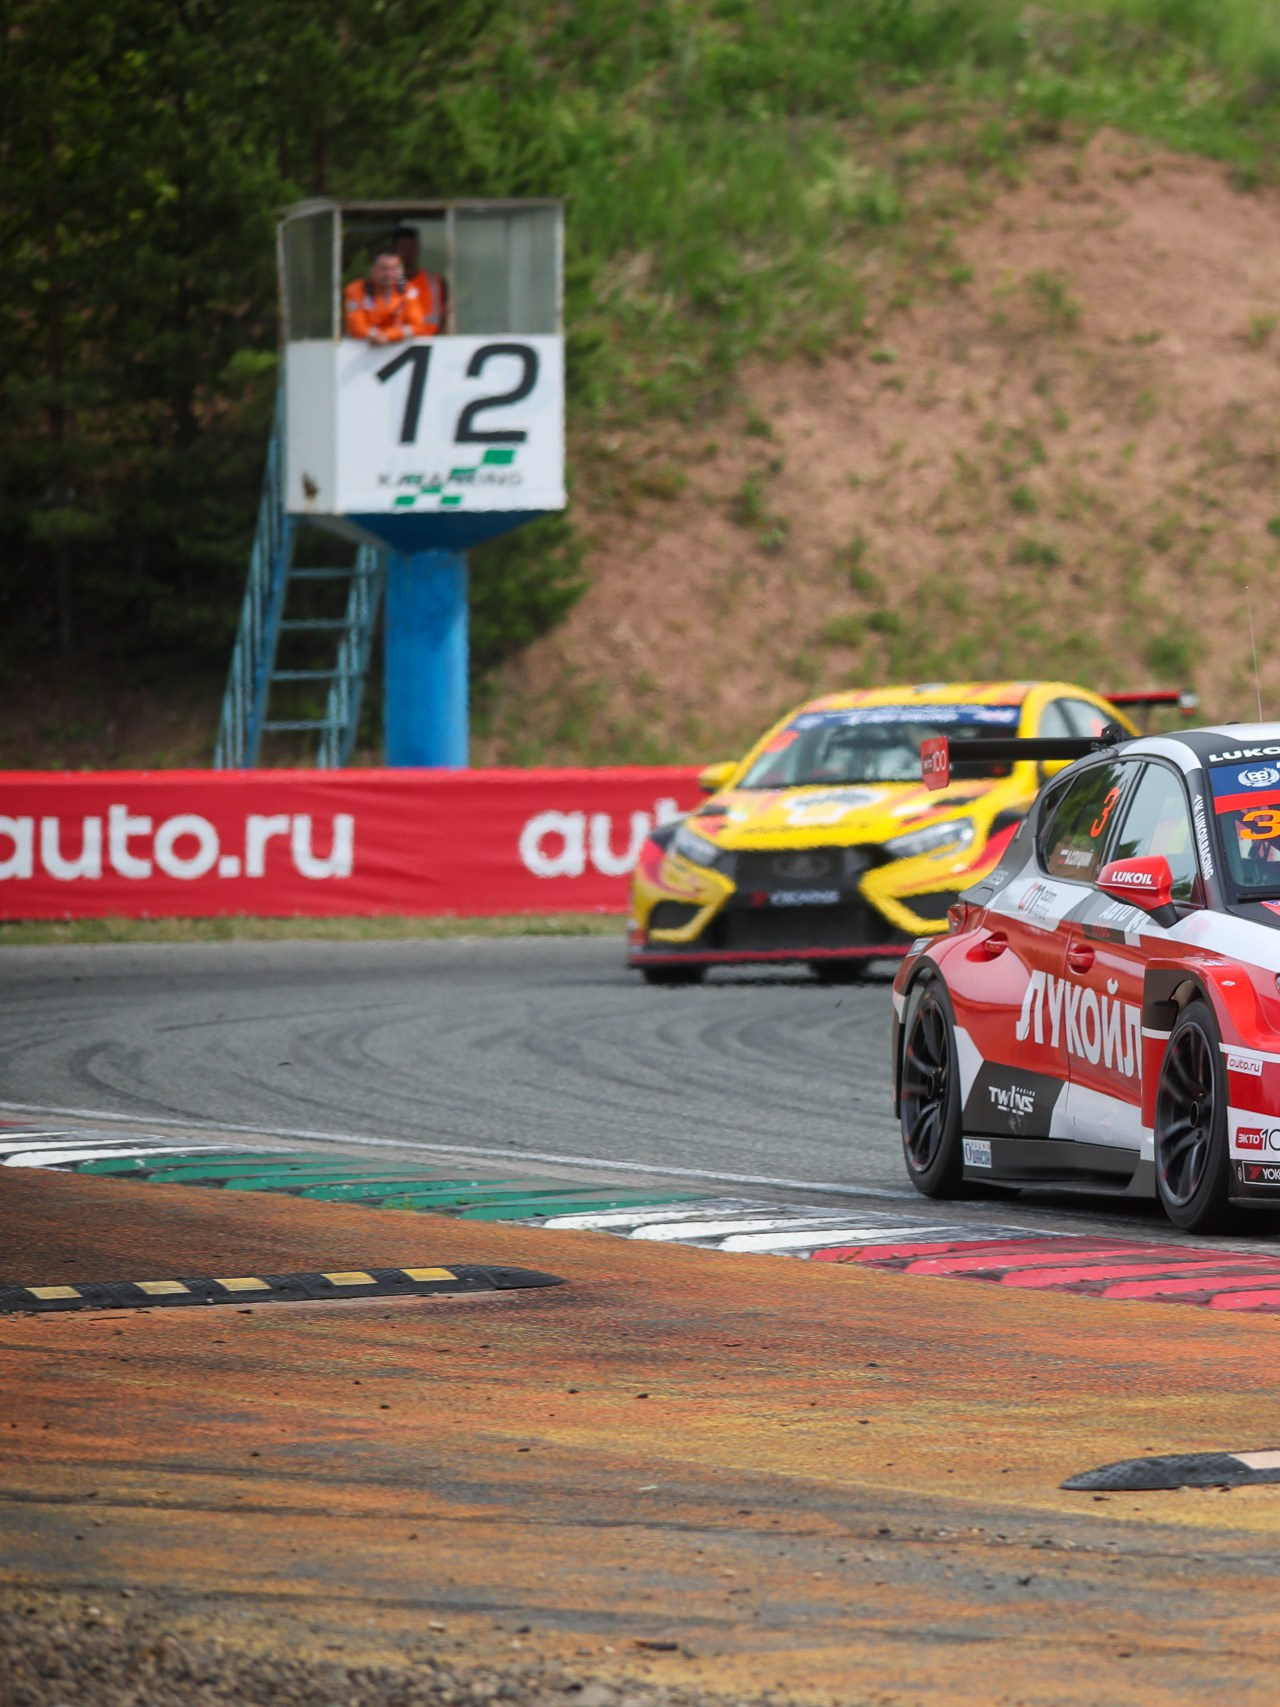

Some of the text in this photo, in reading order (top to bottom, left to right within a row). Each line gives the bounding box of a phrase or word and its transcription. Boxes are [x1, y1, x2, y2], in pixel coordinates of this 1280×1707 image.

[375, 342, 539, 444] 12
[1090, 787, 1120, 838] 3
[1111, 871, 1153, 885] LUKOIL
[1015, 970, 1143, 1080] ЛУКОЙЛ
[1229, 1057, 1261, 1073] auto.ru
[1237, 1133, 1260, 1145] ЭКТО
